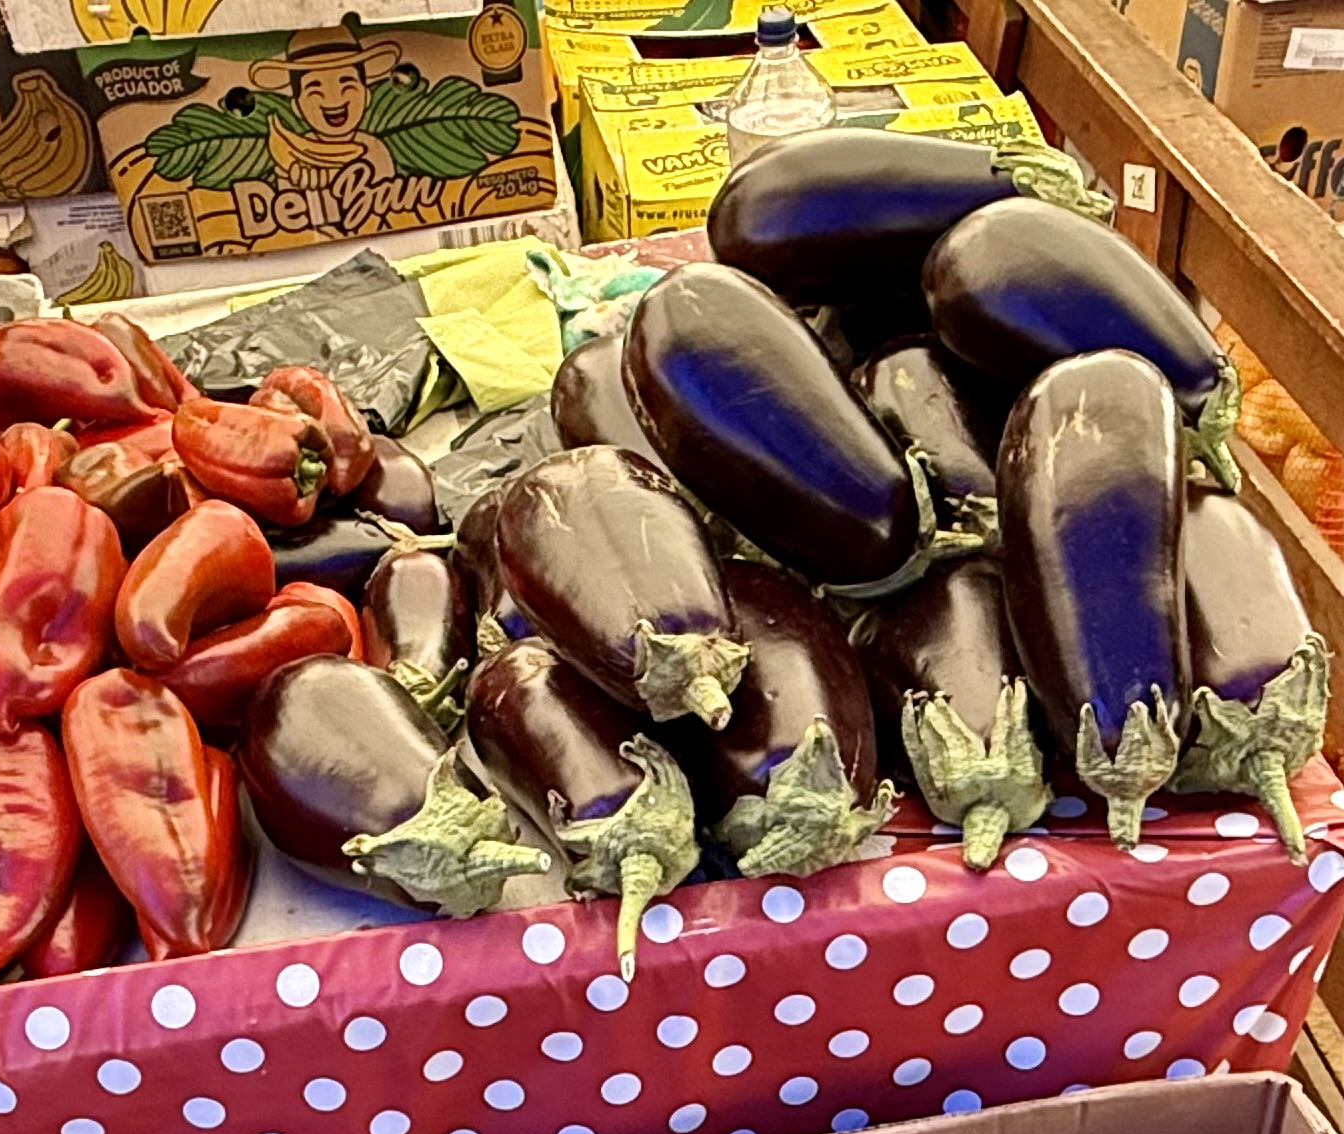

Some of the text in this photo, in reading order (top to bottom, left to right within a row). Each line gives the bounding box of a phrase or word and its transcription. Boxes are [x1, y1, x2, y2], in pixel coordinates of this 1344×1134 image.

[94, 59, 181, 88] PRODUCT OF
[104, 78, 184, 101] ECUADOR
[641, 141, 731, 175] VAMO
[506, 167, 537, 183] NETO
[496, 182, 516, 199] 20
